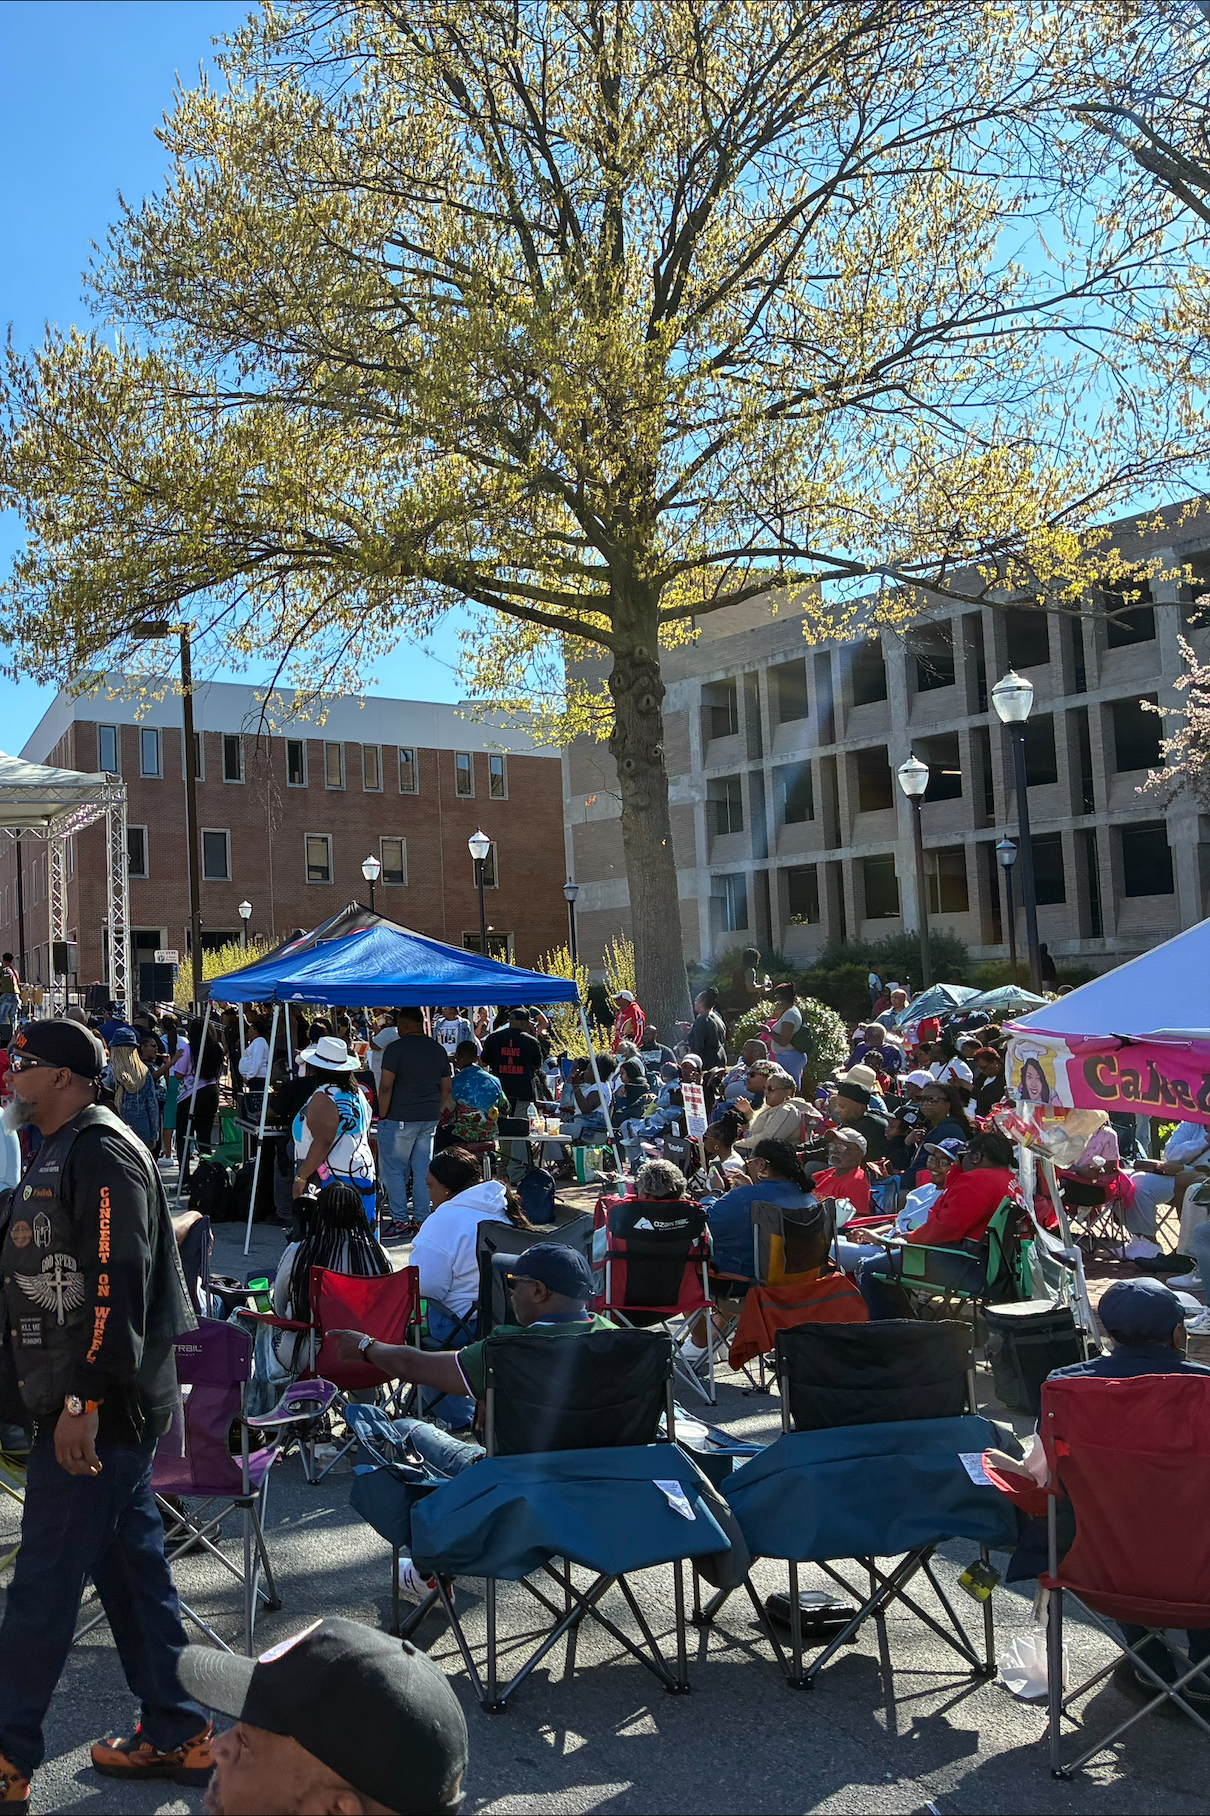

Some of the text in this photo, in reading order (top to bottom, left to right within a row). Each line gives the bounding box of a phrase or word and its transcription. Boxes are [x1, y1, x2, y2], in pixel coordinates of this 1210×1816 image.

[501, 1047, 521, 1057] HAVE
[507, 1057, 514, 1065] A
[499, 1065, 524, 1074] DREAM
[98, 1186, 111, 1264] CONCERT
[41, 1253, 77, 1273] GOD SPEED
[97, 1273, 110, 1298] ON
[21, 1322, 41, 1332] KILL ME
